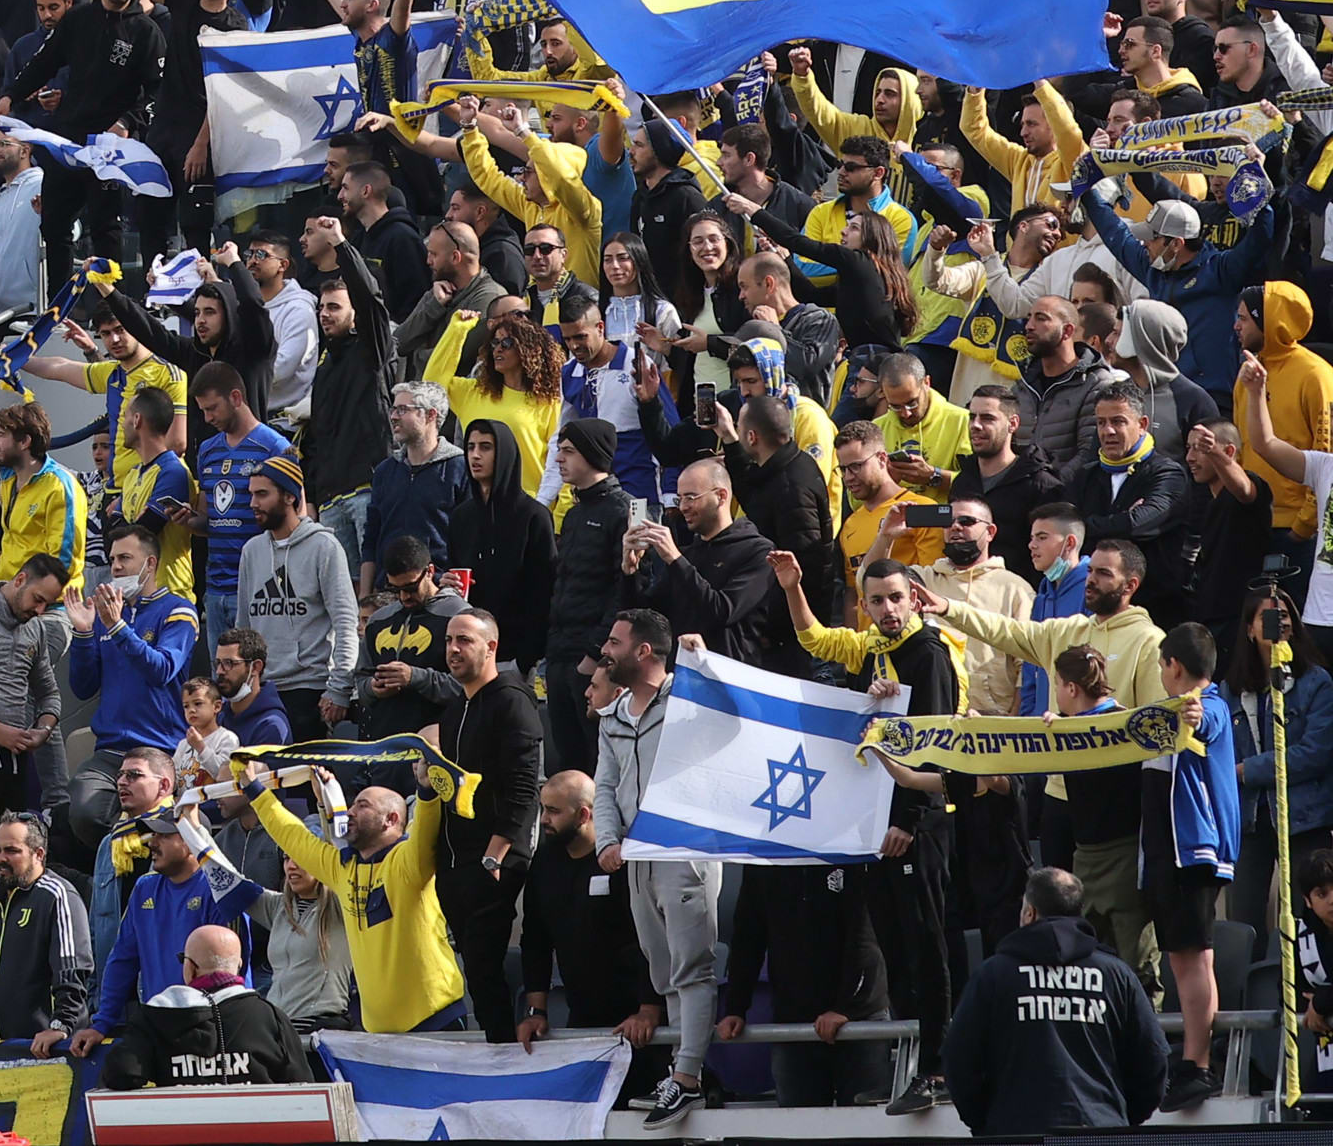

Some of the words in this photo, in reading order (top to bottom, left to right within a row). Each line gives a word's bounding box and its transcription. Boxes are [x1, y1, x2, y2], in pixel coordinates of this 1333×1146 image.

[249, 600, 308, 617] adidas
[976, 732, 1052, 754] המדינה
[1053, 726, 1132, 751] אלופת
[1018, 965, 1104, 993] מטאור
[1017, 995, 1107, 1025] אבטחה
[170, 1051, 250, 1078] אבטחה
